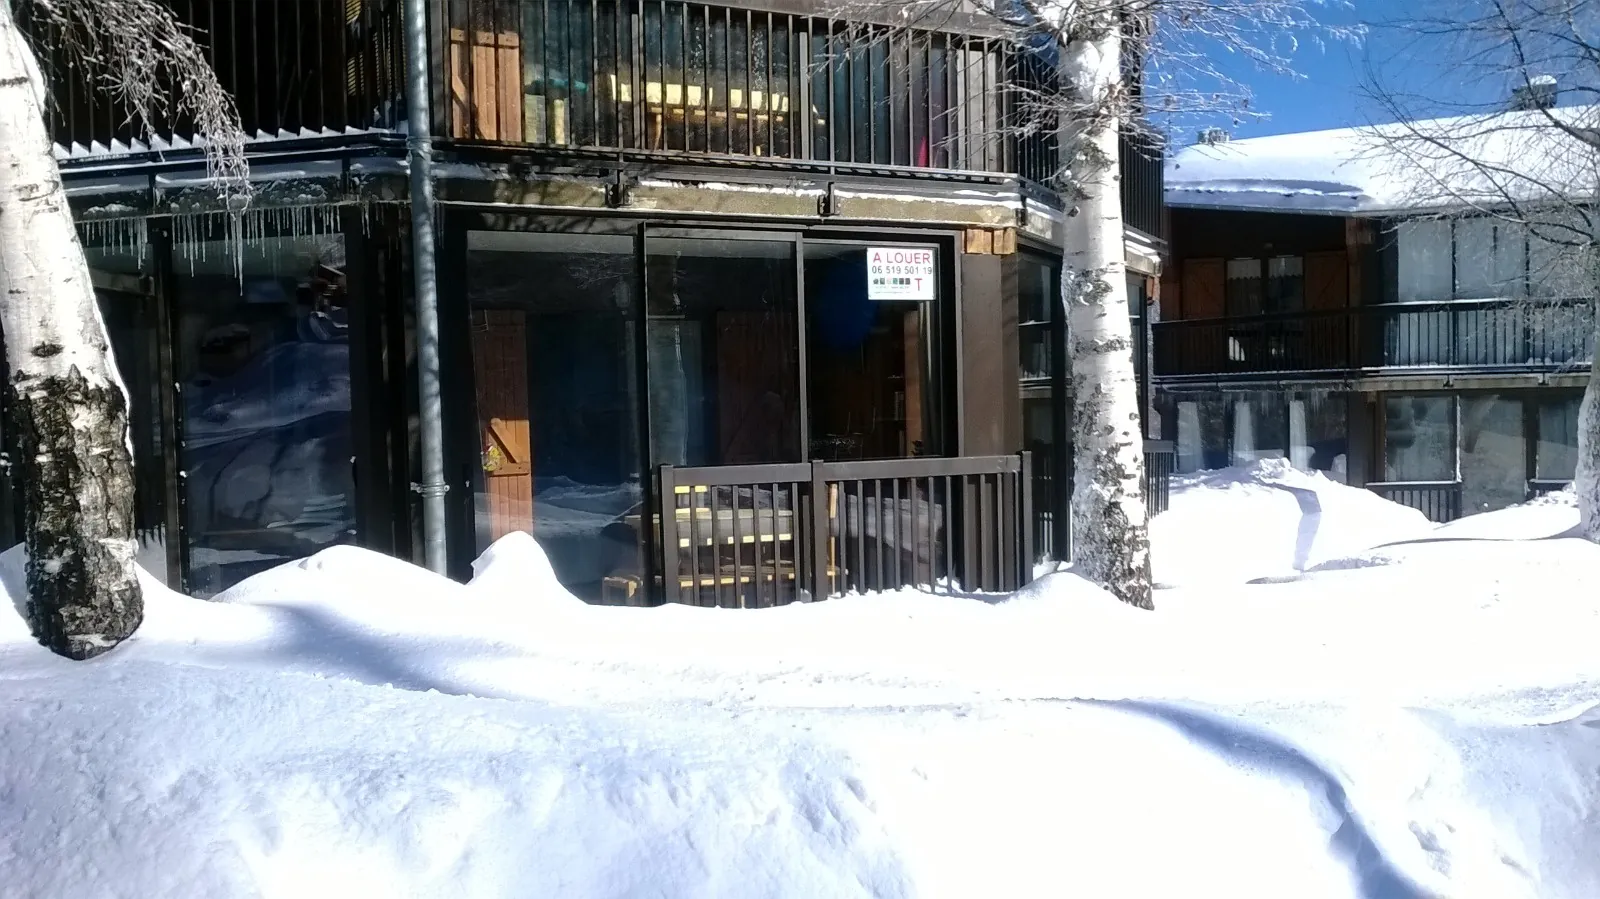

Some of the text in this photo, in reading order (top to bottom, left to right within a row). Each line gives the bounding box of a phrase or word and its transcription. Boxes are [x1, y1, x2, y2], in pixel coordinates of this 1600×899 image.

[873, 252, 931, 264] A LOUER
[872, 265, 933, 275] 06 519 501 19
[914, 278, 923, 291] T
